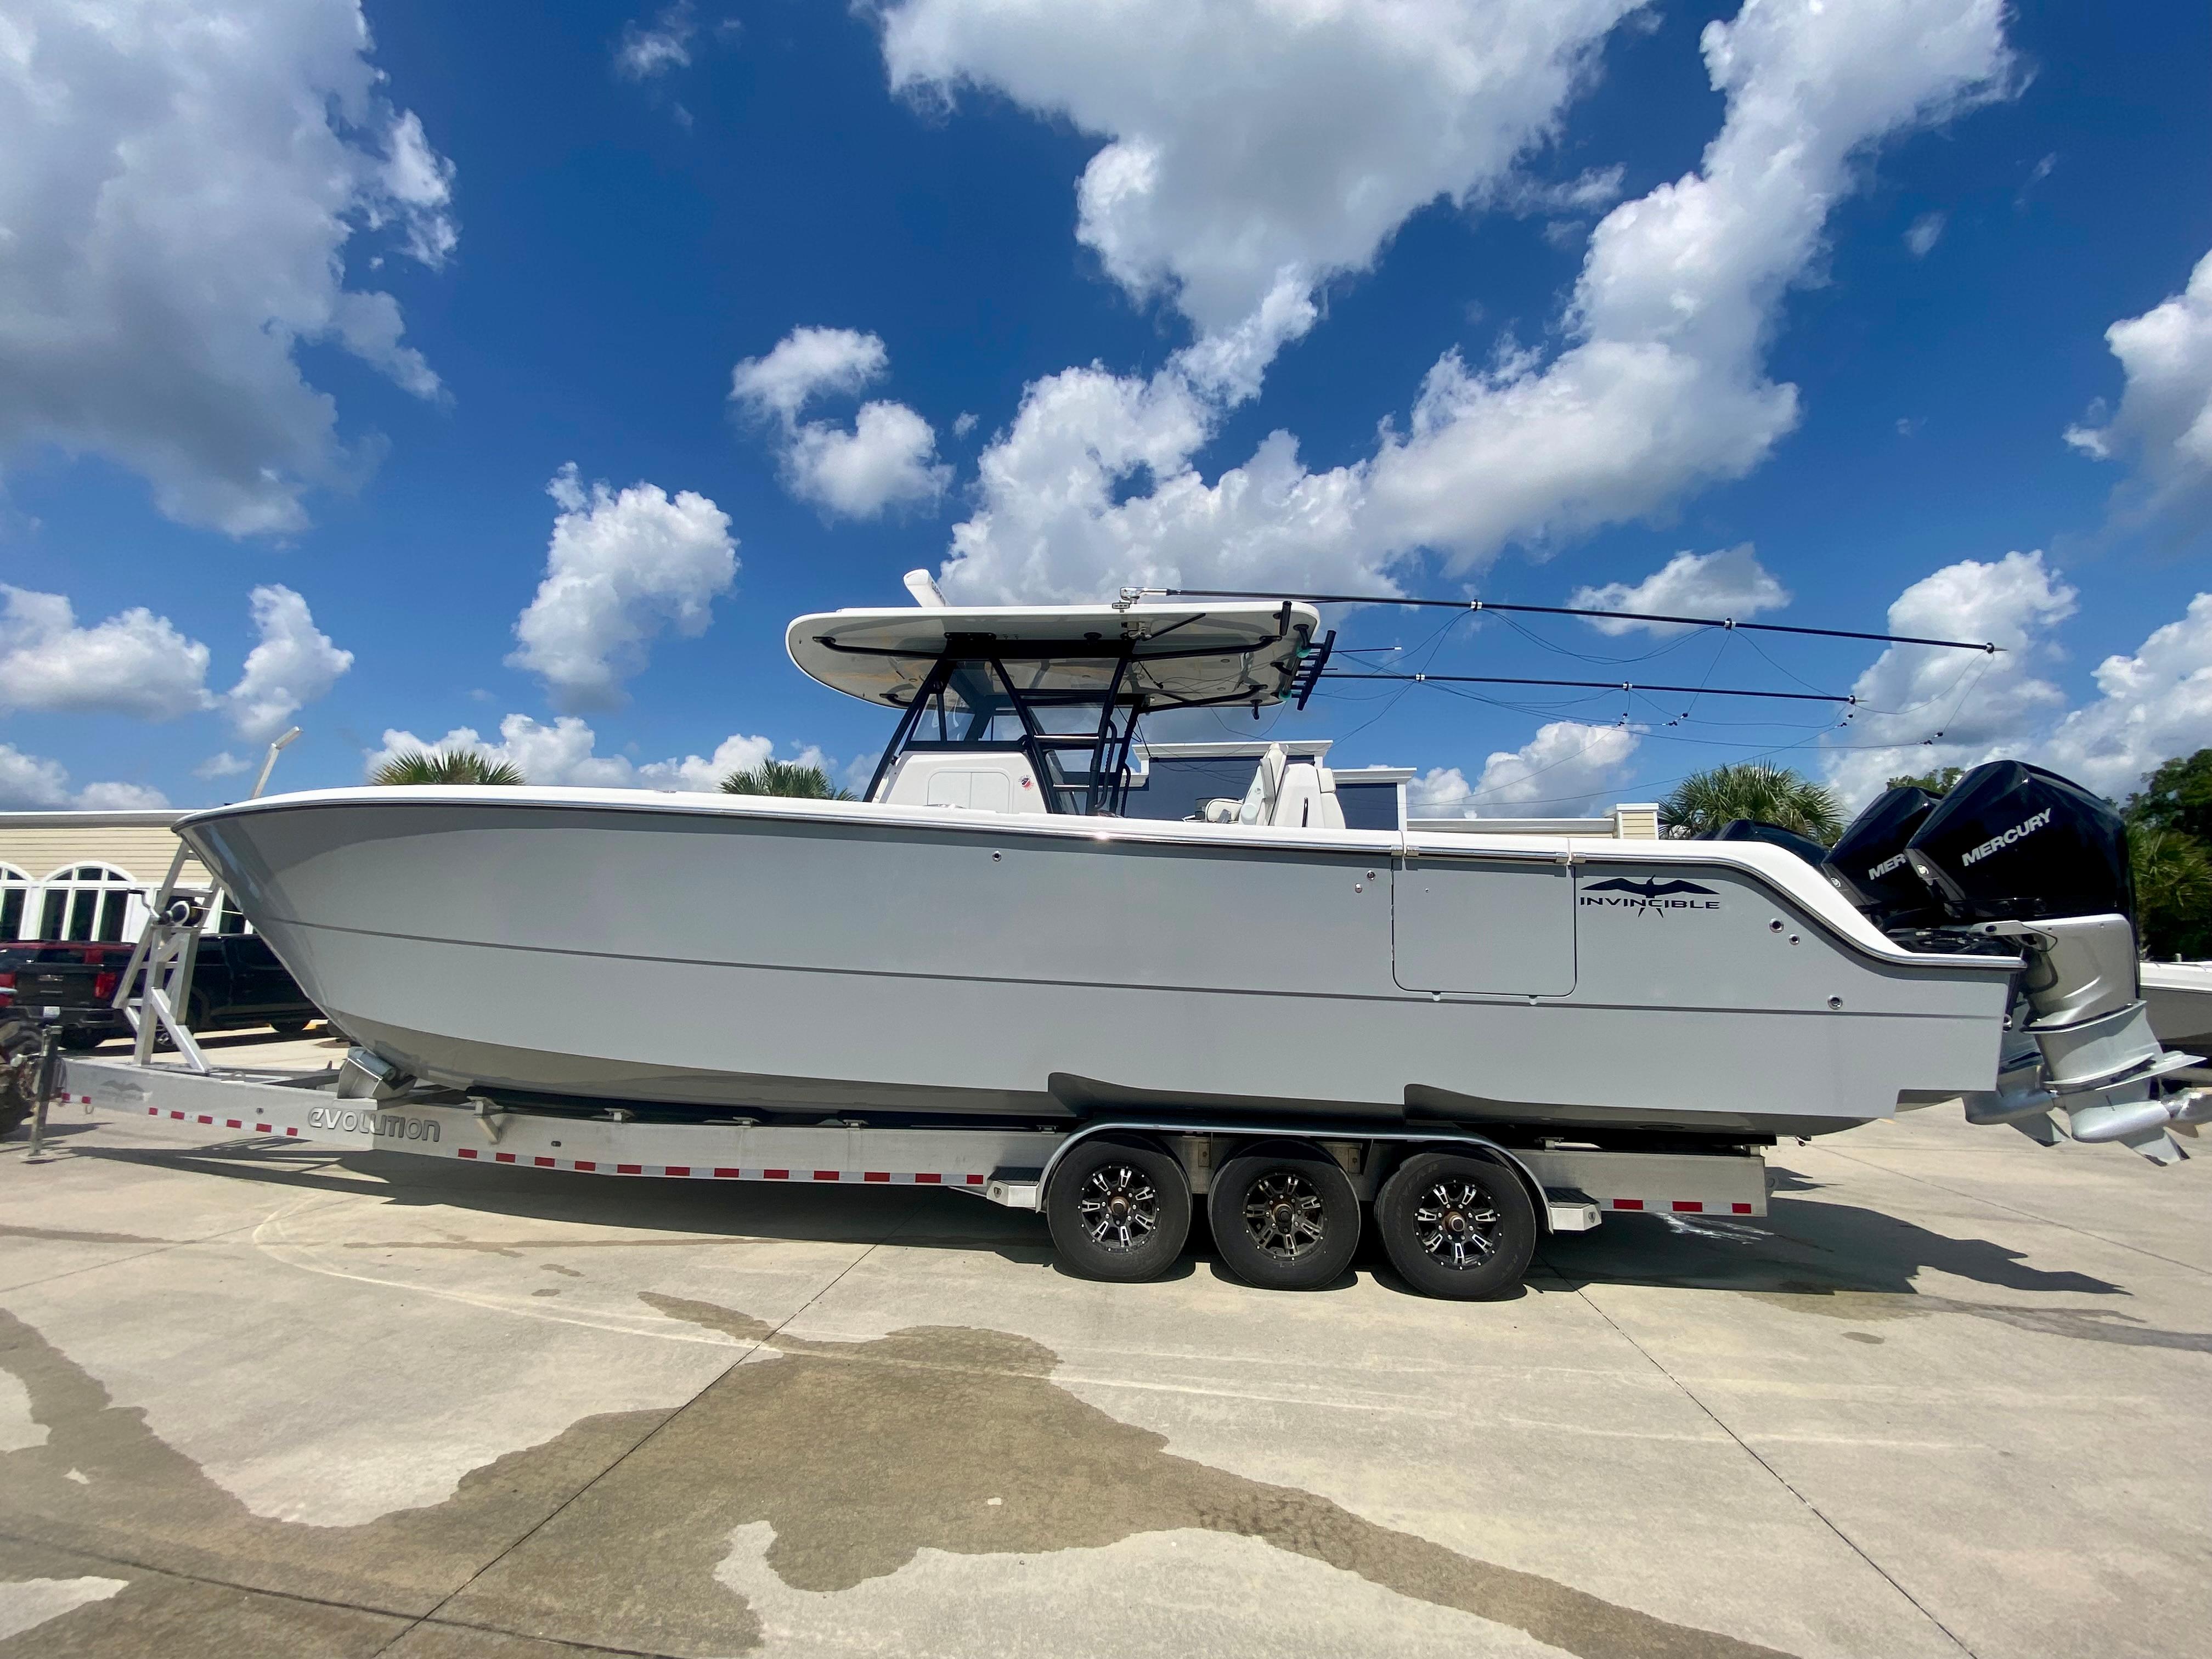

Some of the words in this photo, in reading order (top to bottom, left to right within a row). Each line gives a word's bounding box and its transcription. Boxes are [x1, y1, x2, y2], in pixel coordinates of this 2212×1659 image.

[1961, 808, 2051, 867] MERCURY
[1867, 853, 1907, 881] MER
[1580, 896, 1720, 910] INVINCIBLE
